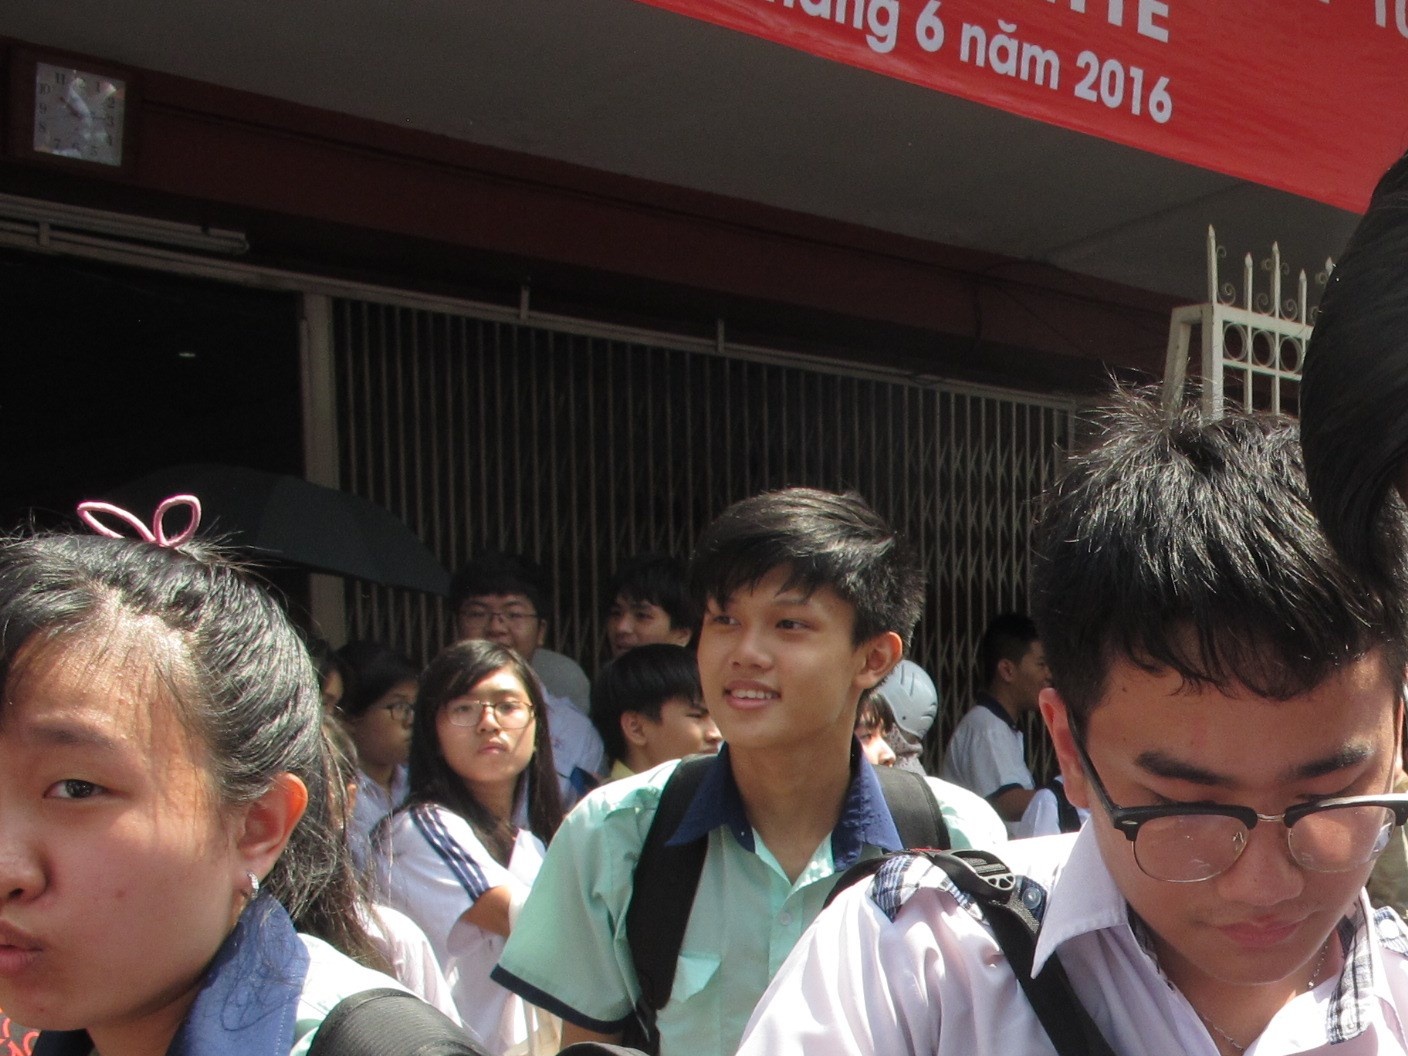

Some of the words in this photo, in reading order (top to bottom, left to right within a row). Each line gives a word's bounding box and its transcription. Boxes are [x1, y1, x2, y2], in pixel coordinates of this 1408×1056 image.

[916, 0, 945, 52] 6
[960, 19, 1060, 90] năm
[1074, 50, 1173, 124] 2016
